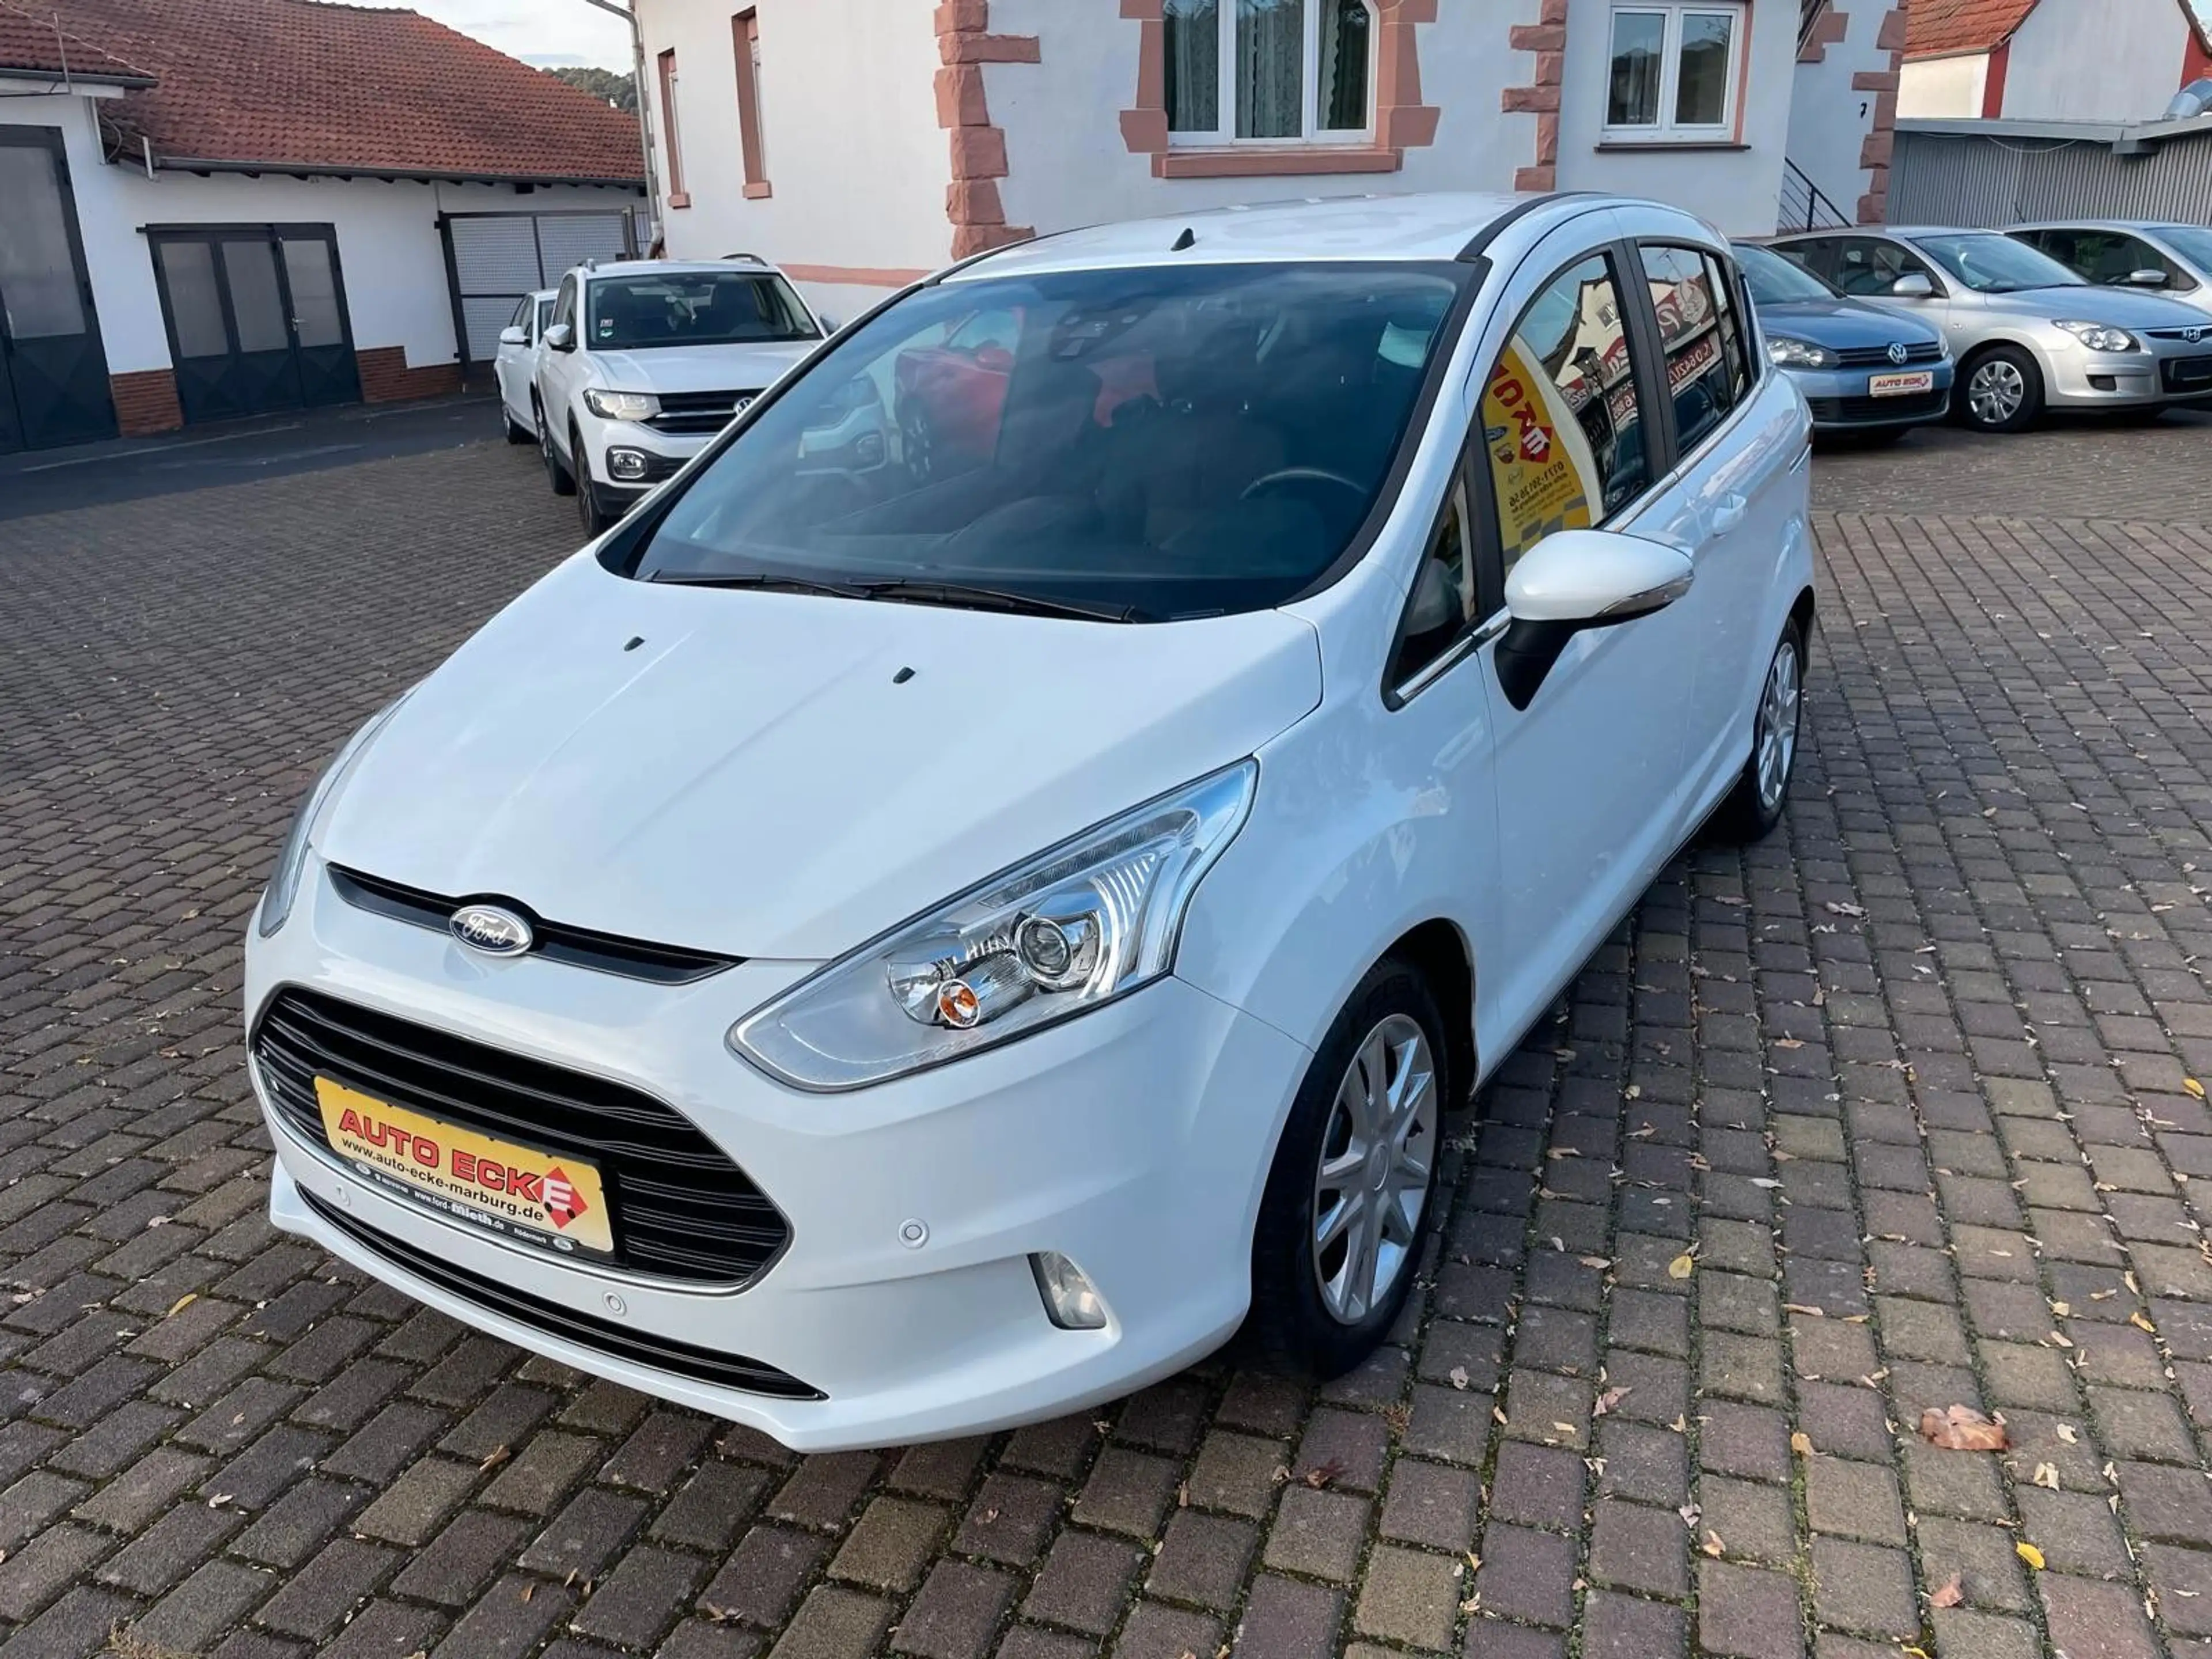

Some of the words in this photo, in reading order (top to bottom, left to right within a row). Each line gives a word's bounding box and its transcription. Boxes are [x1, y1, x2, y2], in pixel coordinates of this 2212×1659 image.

[1860, 101, 1868, 119] 7
[462, 913, 510, 945] Ford
[338, 1108, 440, 1169] AUTO
[342, 1138, 544, 1222] www.auto-ecke-marburg.de
